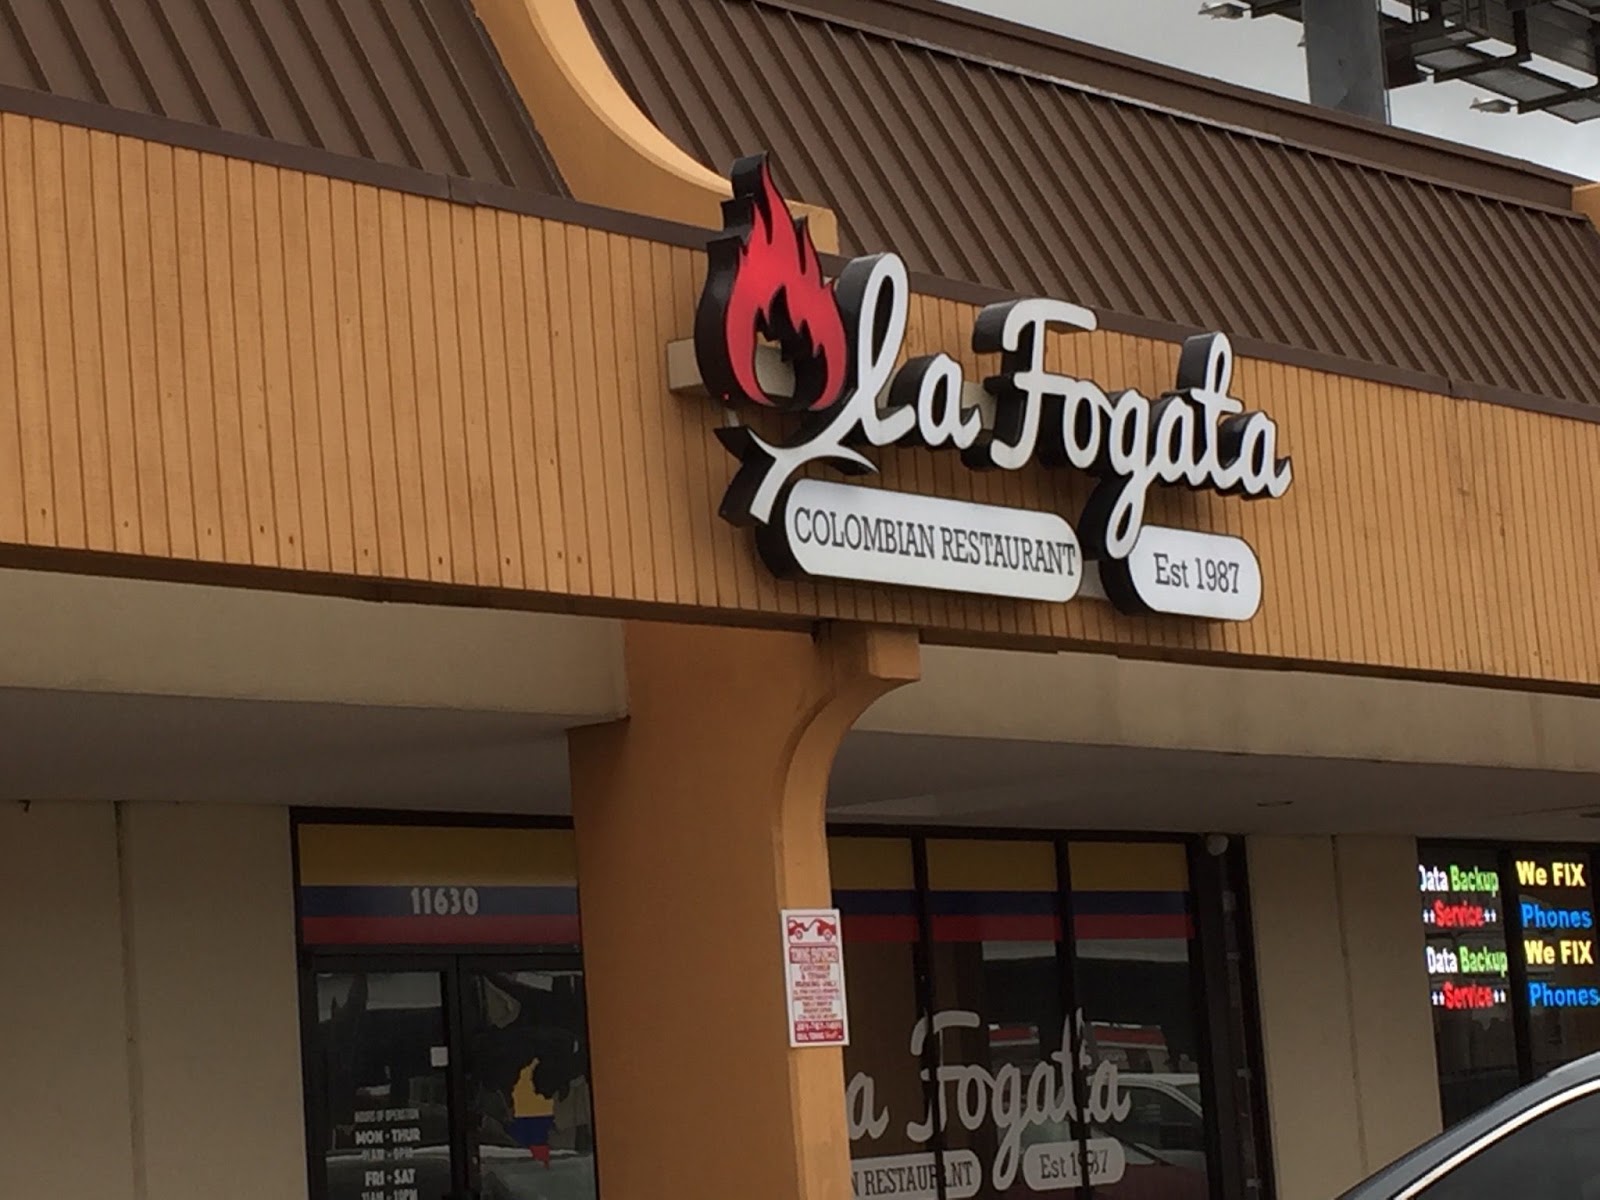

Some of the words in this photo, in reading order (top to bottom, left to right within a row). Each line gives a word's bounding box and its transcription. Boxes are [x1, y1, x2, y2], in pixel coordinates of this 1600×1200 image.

[989, 299, 1293, 560] Fogata
[794, 507, 935, 560] COLOMBIAN
[941, 525, 1076, 578] RESTAURANT
[1154, 552, 1189, 589] Est
[1194, 556, 1239, 594] 1987
[1450, 864, 1499, 897] Backup
[1516, 860, 1548, 886] We
[1552, 862, 1586, 887] FIX
[410, 887, 479, 916] 11630
[1434, 899, 1485, 928] Service
[1520, 902, 1593, 928] Phones
[1426, 945, 1458, 974] Data
[1459, 945, 1508, 978] Backup
[1524, 940, 1556, 965] We
[1560, 940, 1594, 965] FIX
[1442, 980, 1494, 1010] Service
[1528, 982, 1600, 1008] Phones
[354, 1129, 384, 1145] MON
[391, 1127, 421, 1143] THUR
[365, 1170, 385, 1187] FRI
[394, 1168, 416, 1185] SAT
[864, 1160, 973, 1196] RESTAURNT
[1039, 1152, 1067, 1179] Est
